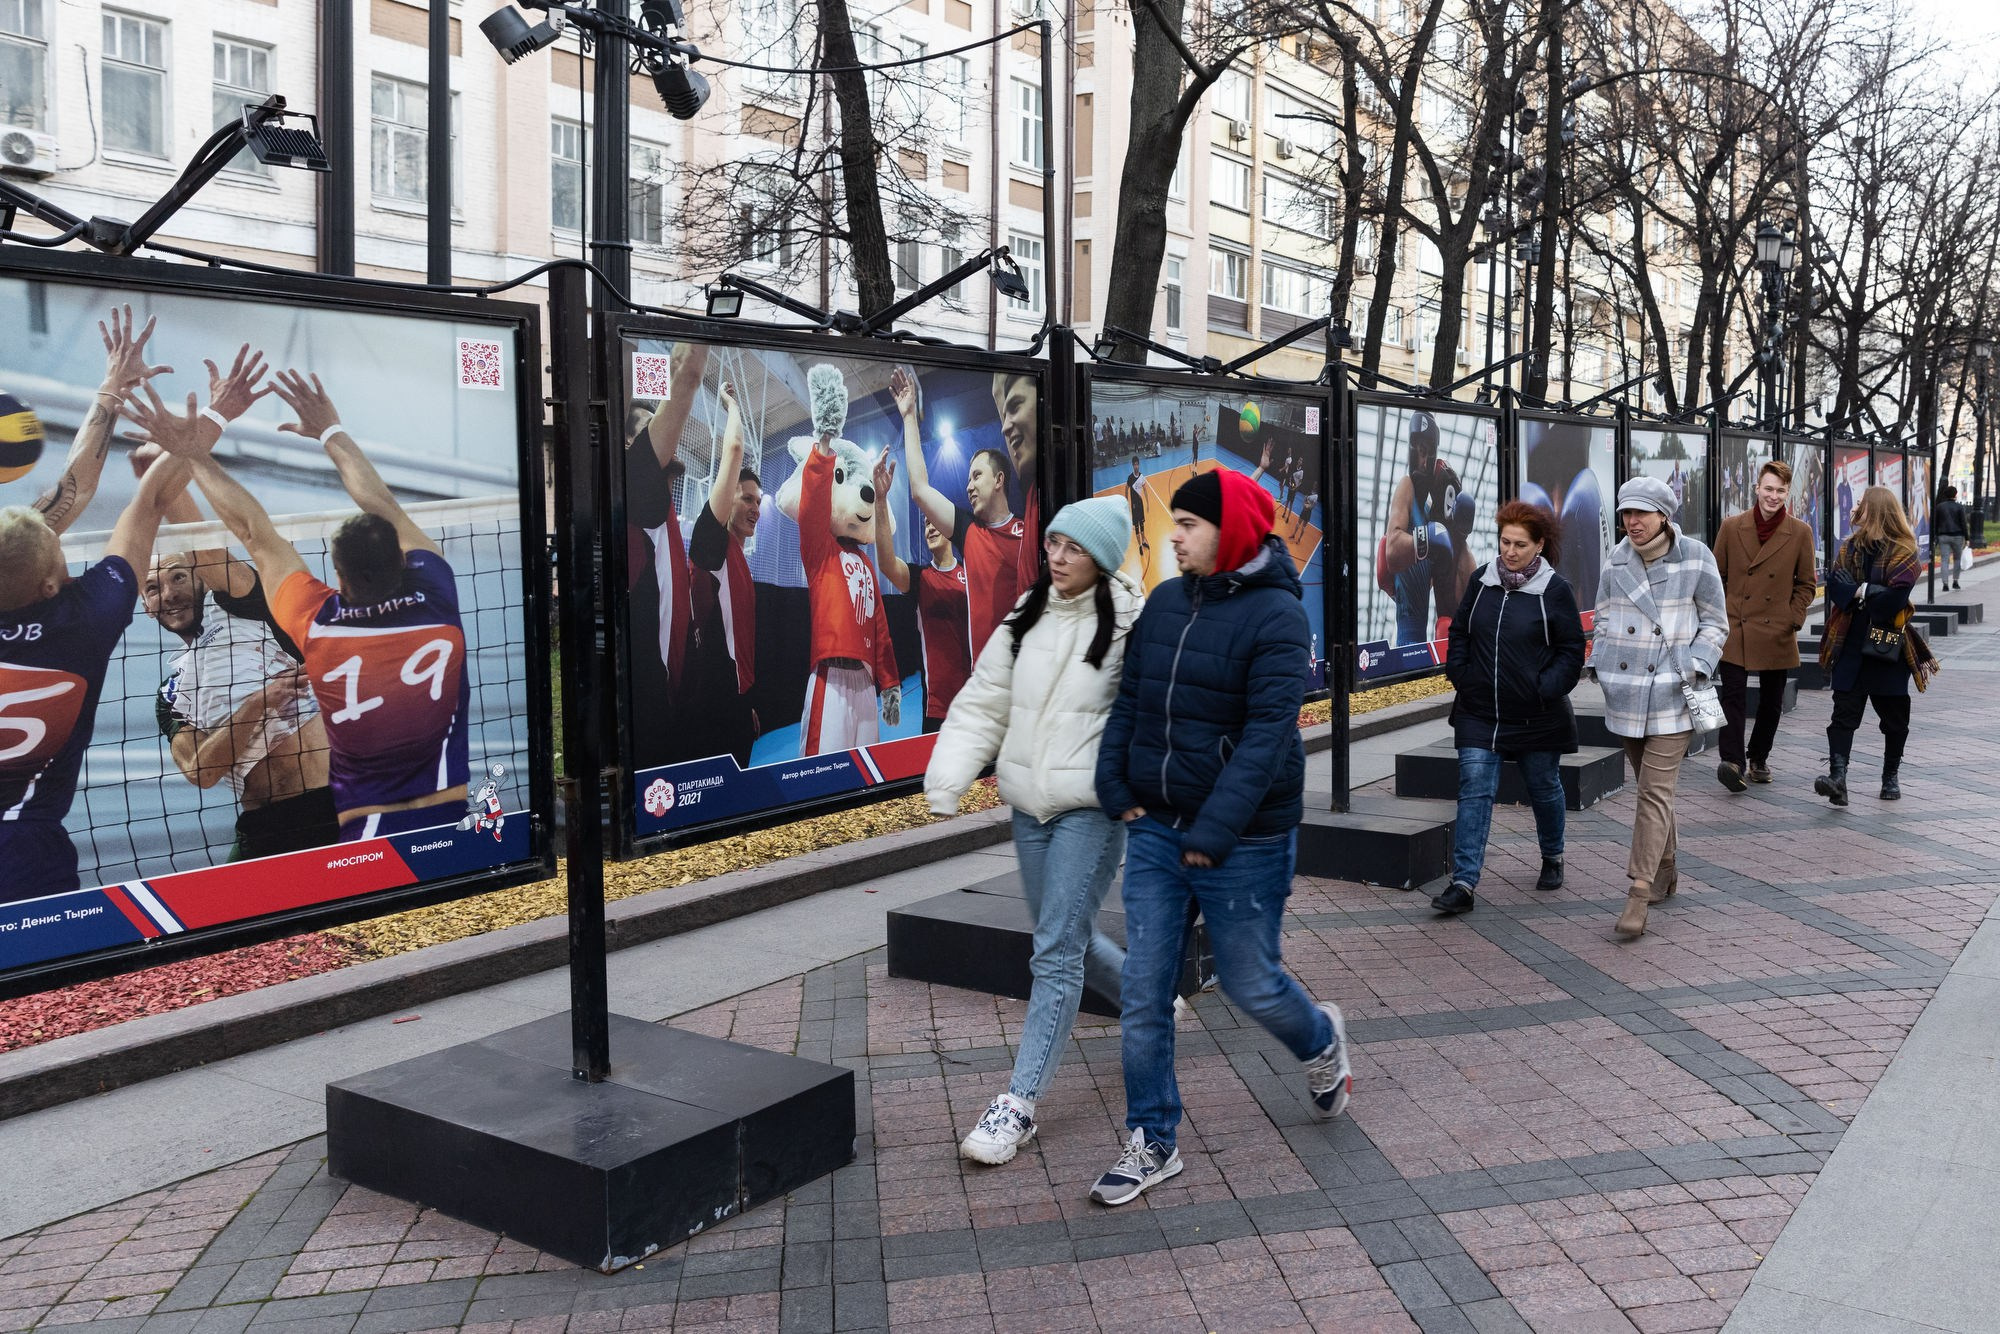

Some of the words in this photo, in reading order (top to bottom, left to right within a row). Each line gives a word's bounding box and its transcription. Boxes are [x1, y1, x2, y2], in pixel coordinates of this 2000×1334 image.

[322, 638, 454, 725] 19
[781, 771, 799, 781] Автор
[800, 768, 815, 778] фото:
[815, 764, 833, 774] Денис
[677, 775, 724, 792] СПАРТАКИАДА
[648, 785, 672, 805] МОСПРОМ
[678, 791, 702, 807] 2021
[411, 839, 453, 854] Волейбол
[327, 851, 384, 869] #МОСПРОМ
[21, 914, 62, 930] Денис
[64, 906, 103, 920] Тырин
